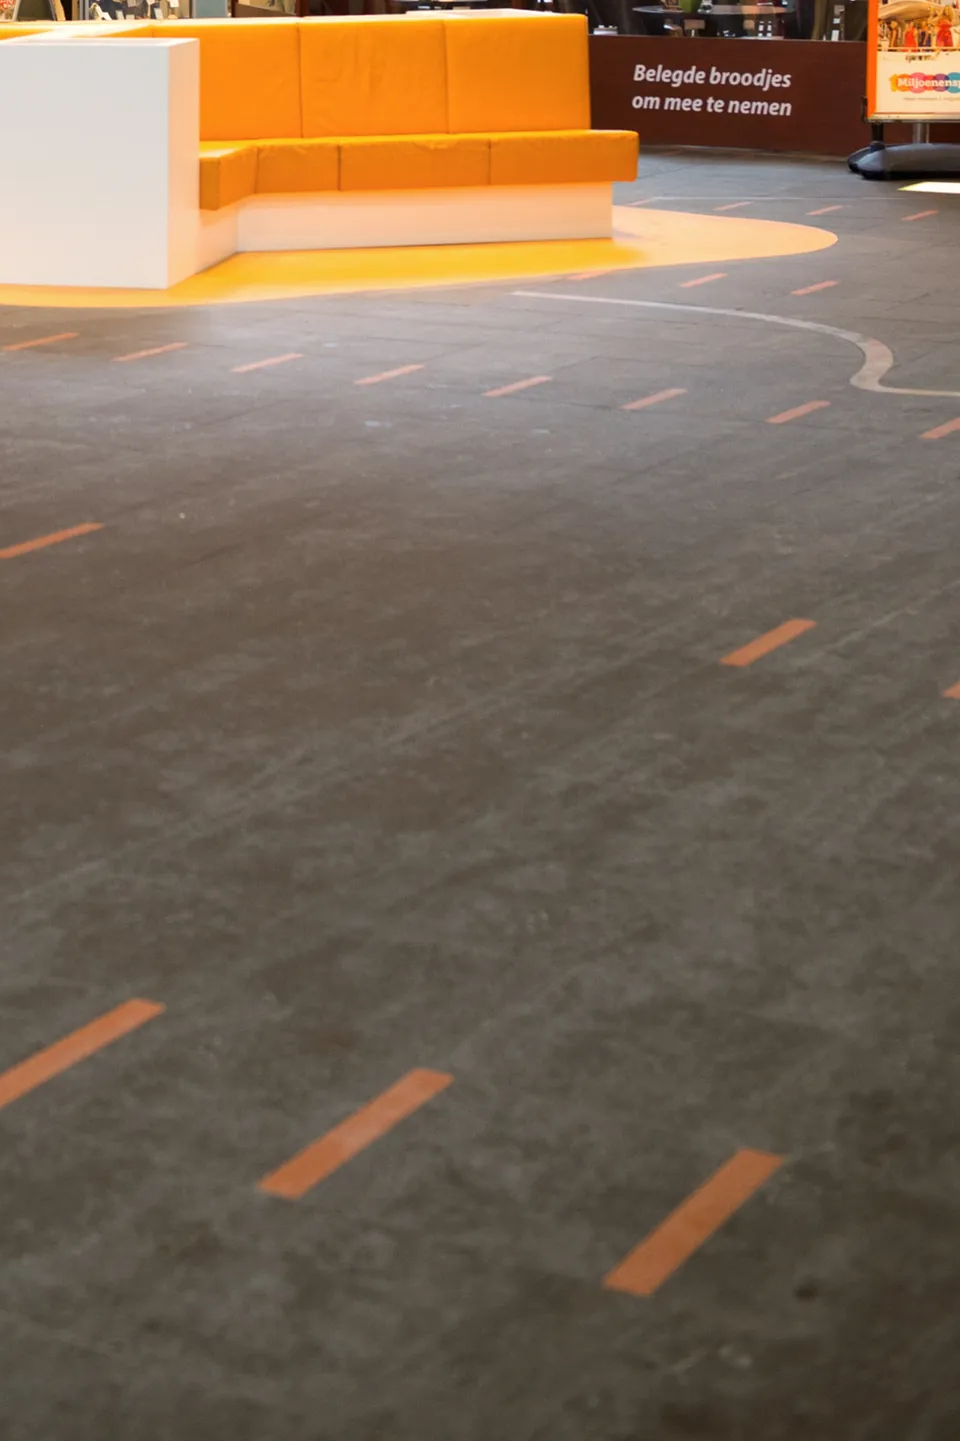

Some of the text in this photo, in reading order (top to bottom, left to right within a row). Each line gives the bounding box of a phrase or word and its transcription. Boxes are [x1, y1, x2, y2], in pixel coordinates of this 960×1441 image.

[633, 64, 792, 91] Belegde broodjes
[632, 95, 792, 116] om mee te nemen
